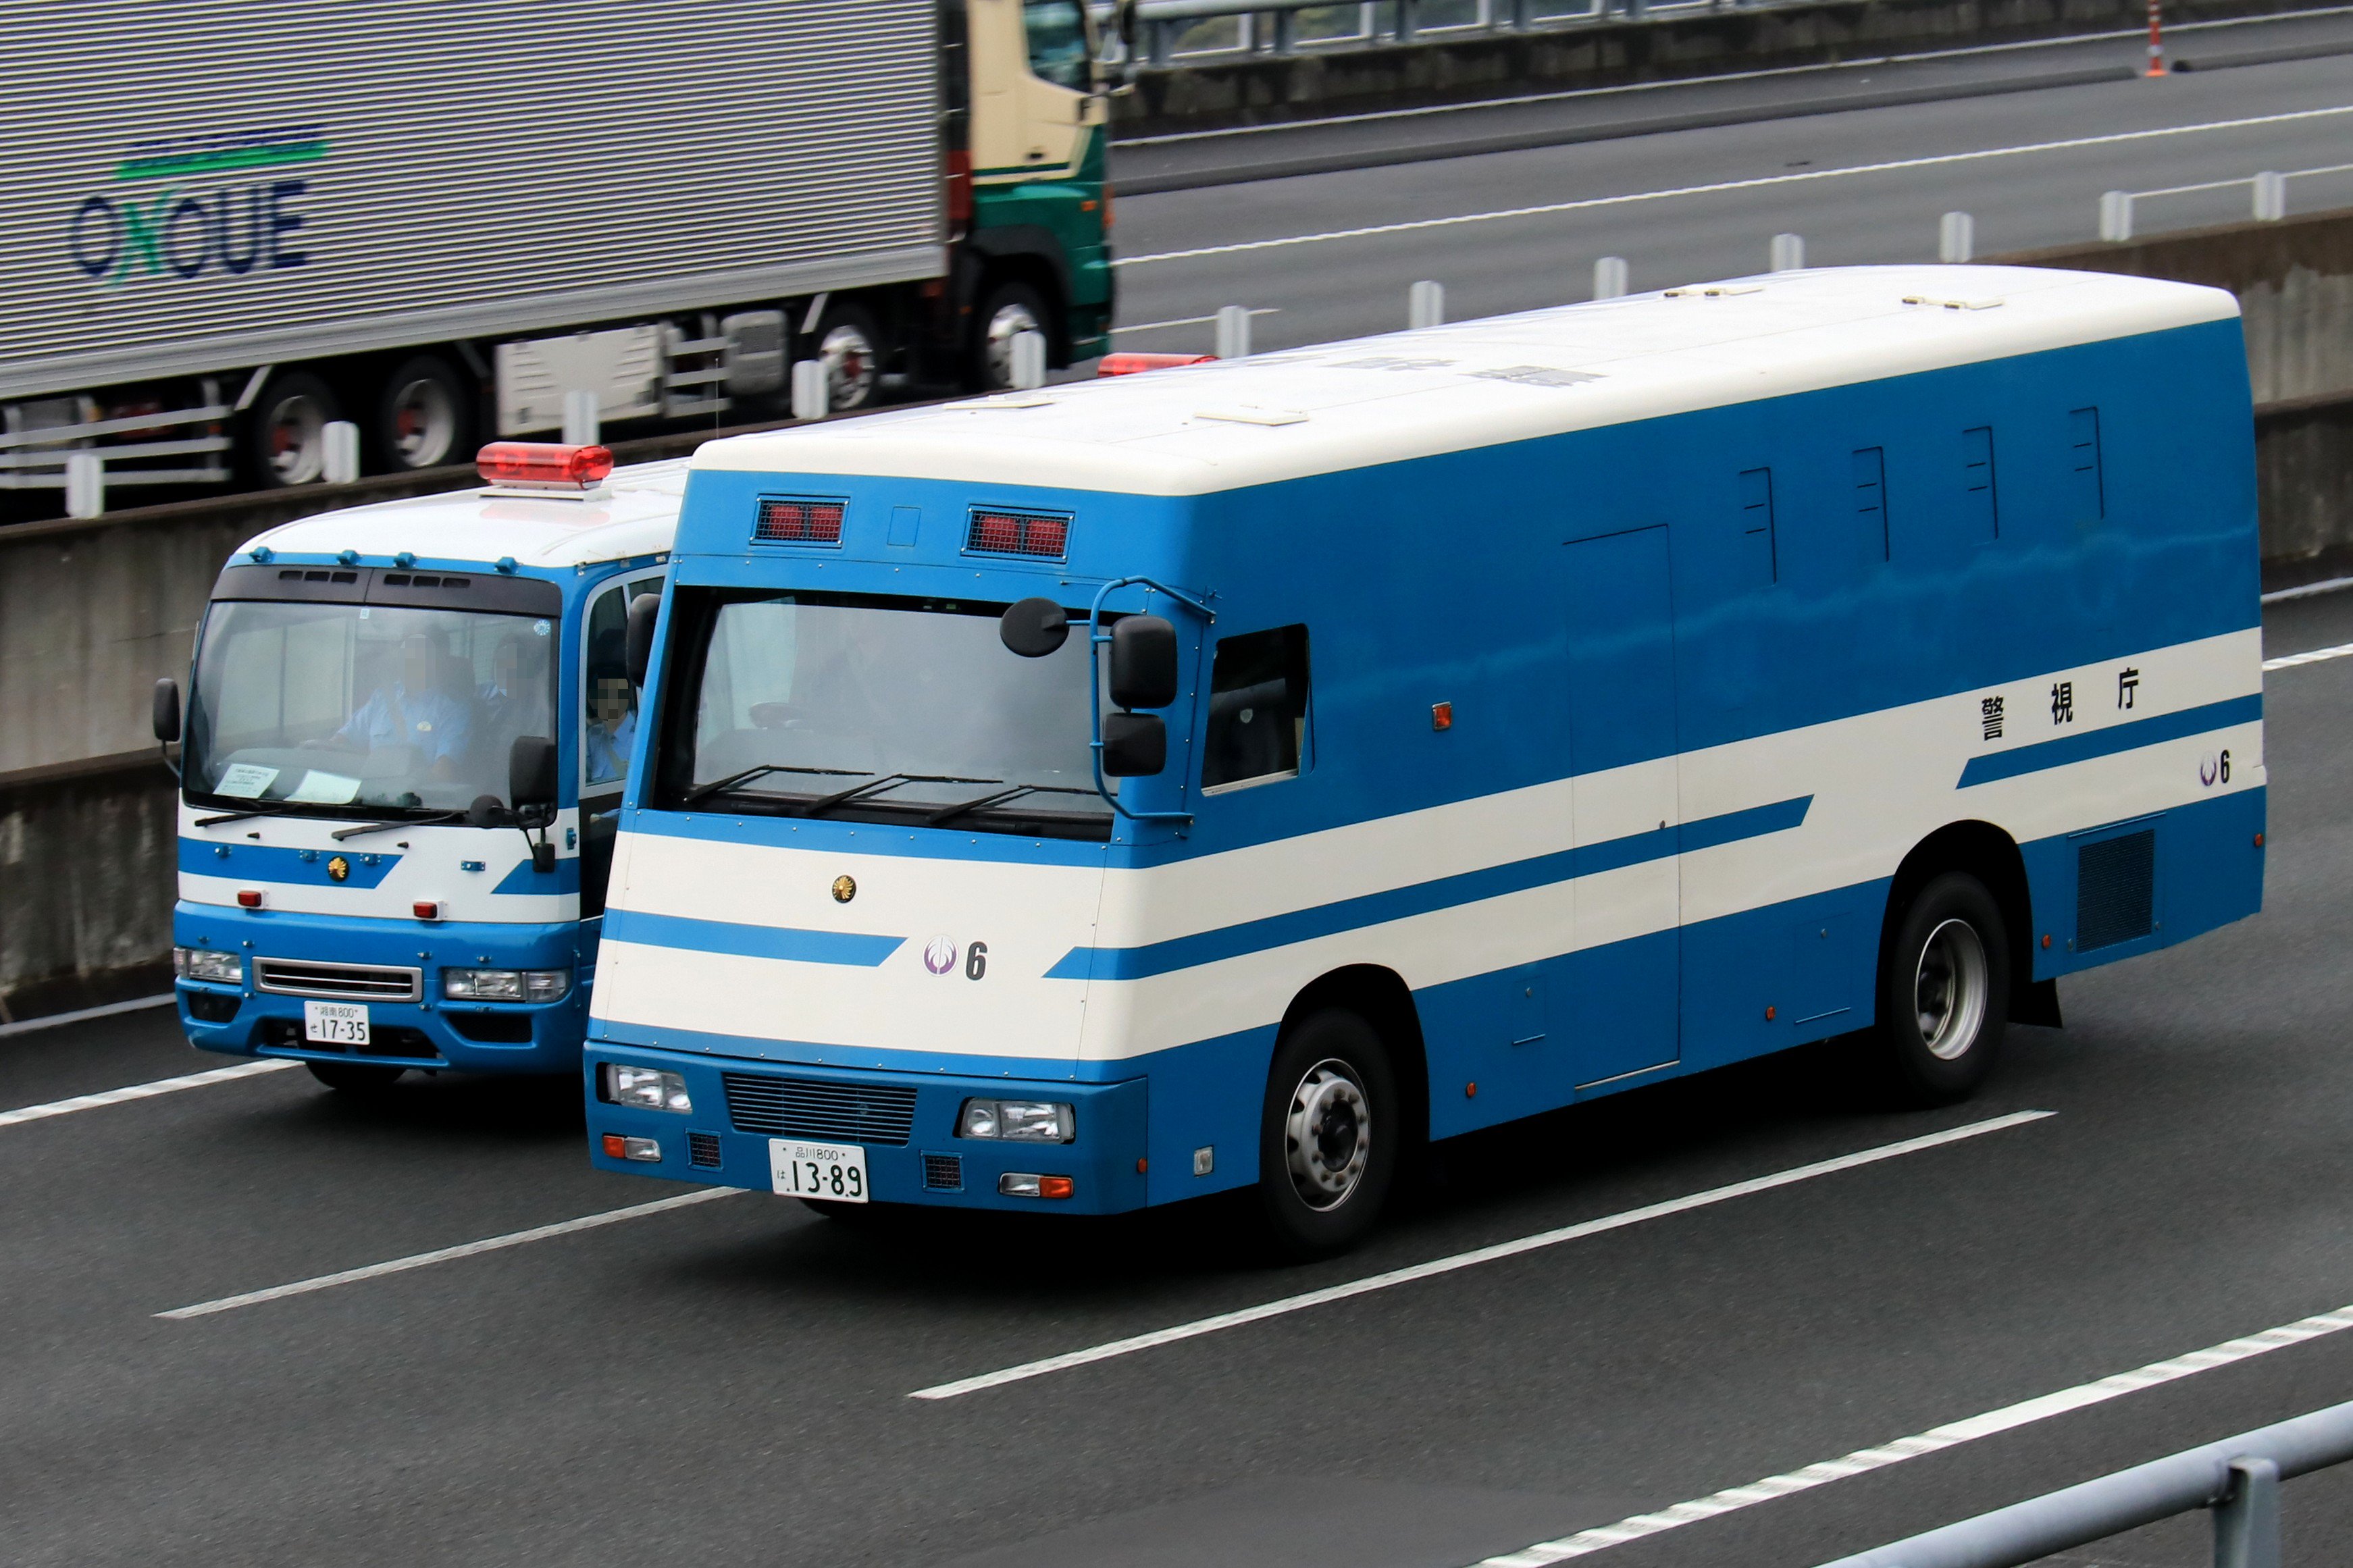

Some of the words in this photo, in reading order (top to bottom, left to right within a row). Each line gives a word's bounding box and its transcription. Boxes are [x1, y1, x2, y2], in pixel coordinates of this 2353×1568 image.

[1982, 667, 2139, 741] 警視庁
[2220, 750, 2230, 784] 6
[966, 941, 987, 981] 6
[322, 1018, 365, 1041] 17-35
[777, 1170, 785, 1180] は
[792, 1160, 862, 1197] 13-89
